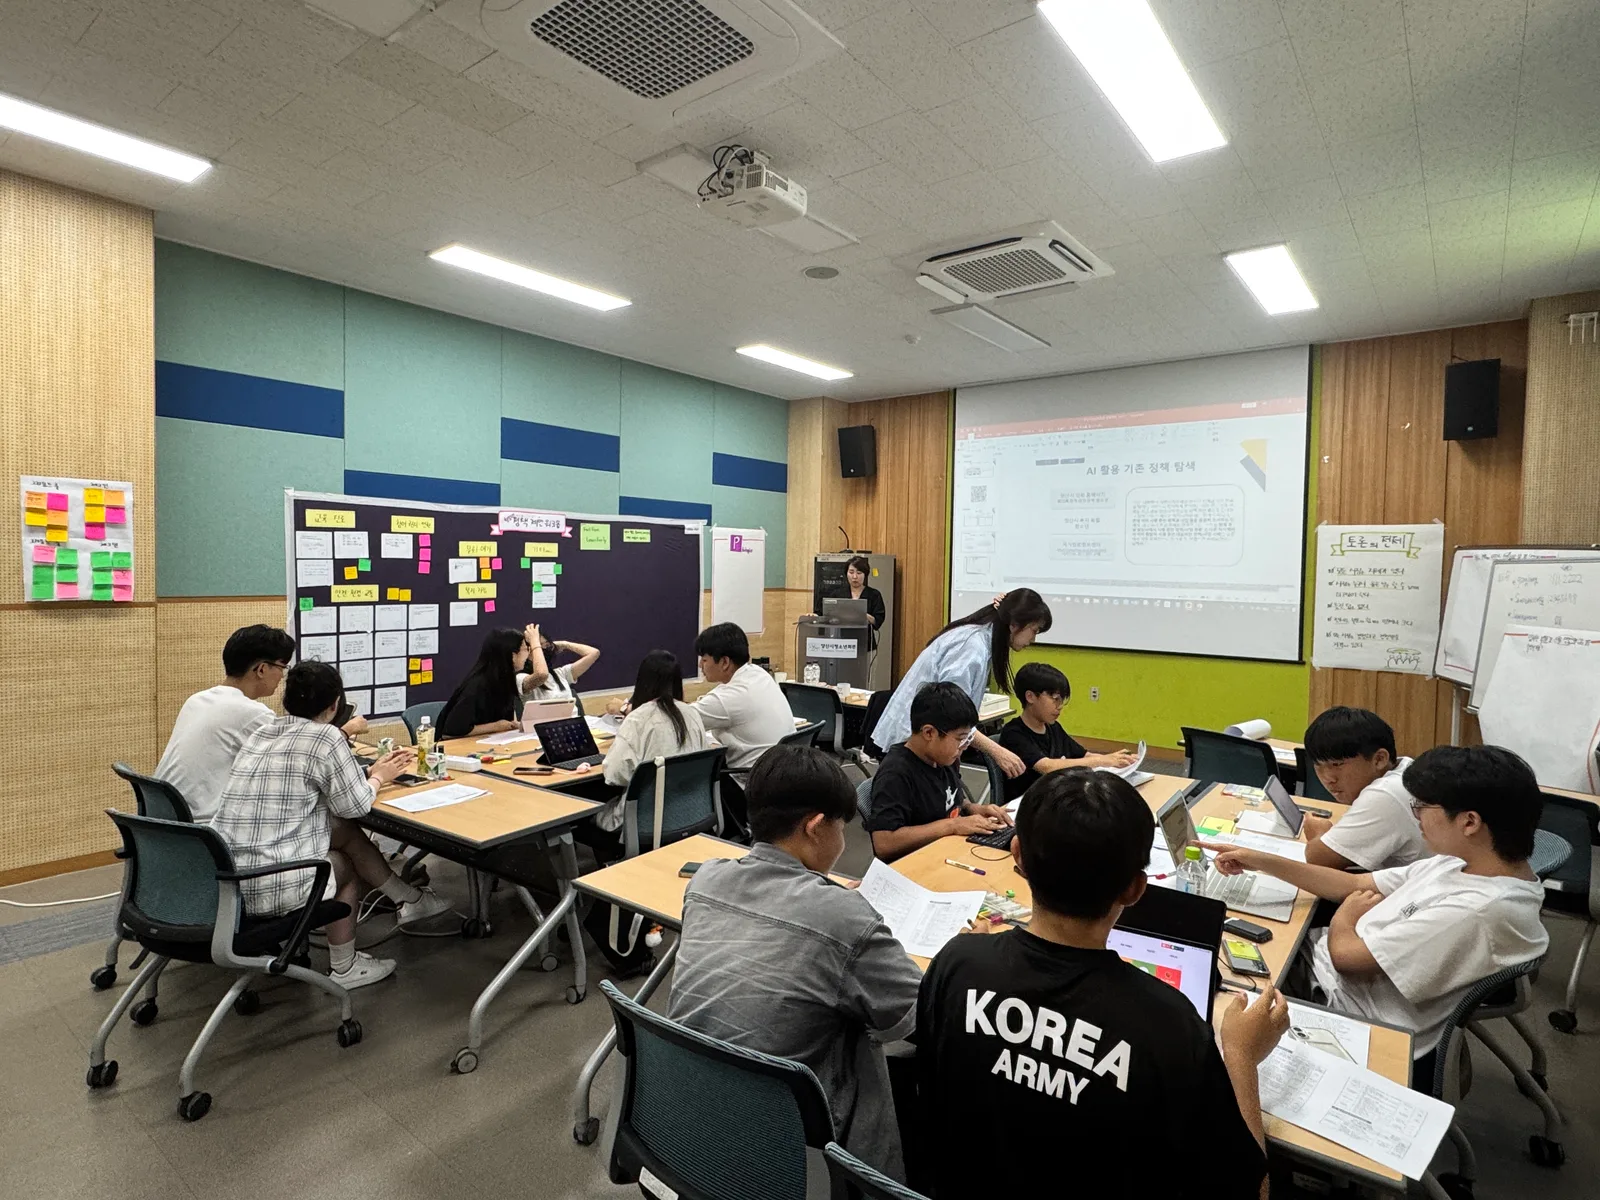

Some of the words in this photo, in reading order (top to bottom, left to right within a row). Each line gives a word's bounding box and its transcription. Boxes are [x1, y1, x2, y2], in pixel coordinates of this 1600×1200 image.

[1086, 467, 1097, 476] AI
[1100, 464, 1120, 475] 활용
[1124, 463, 1145, 474] 기존
[1148, 461, 1170, 473] 정책
[1174, 461, 1196, 472] 탐색
[1346, 535, 1379, 549] 토론의
[1381, 534, 1407, 549] 전제
[964, 988, 1133, 1093] KOREA
[991, 1048, 1091, 1106] ARMY
